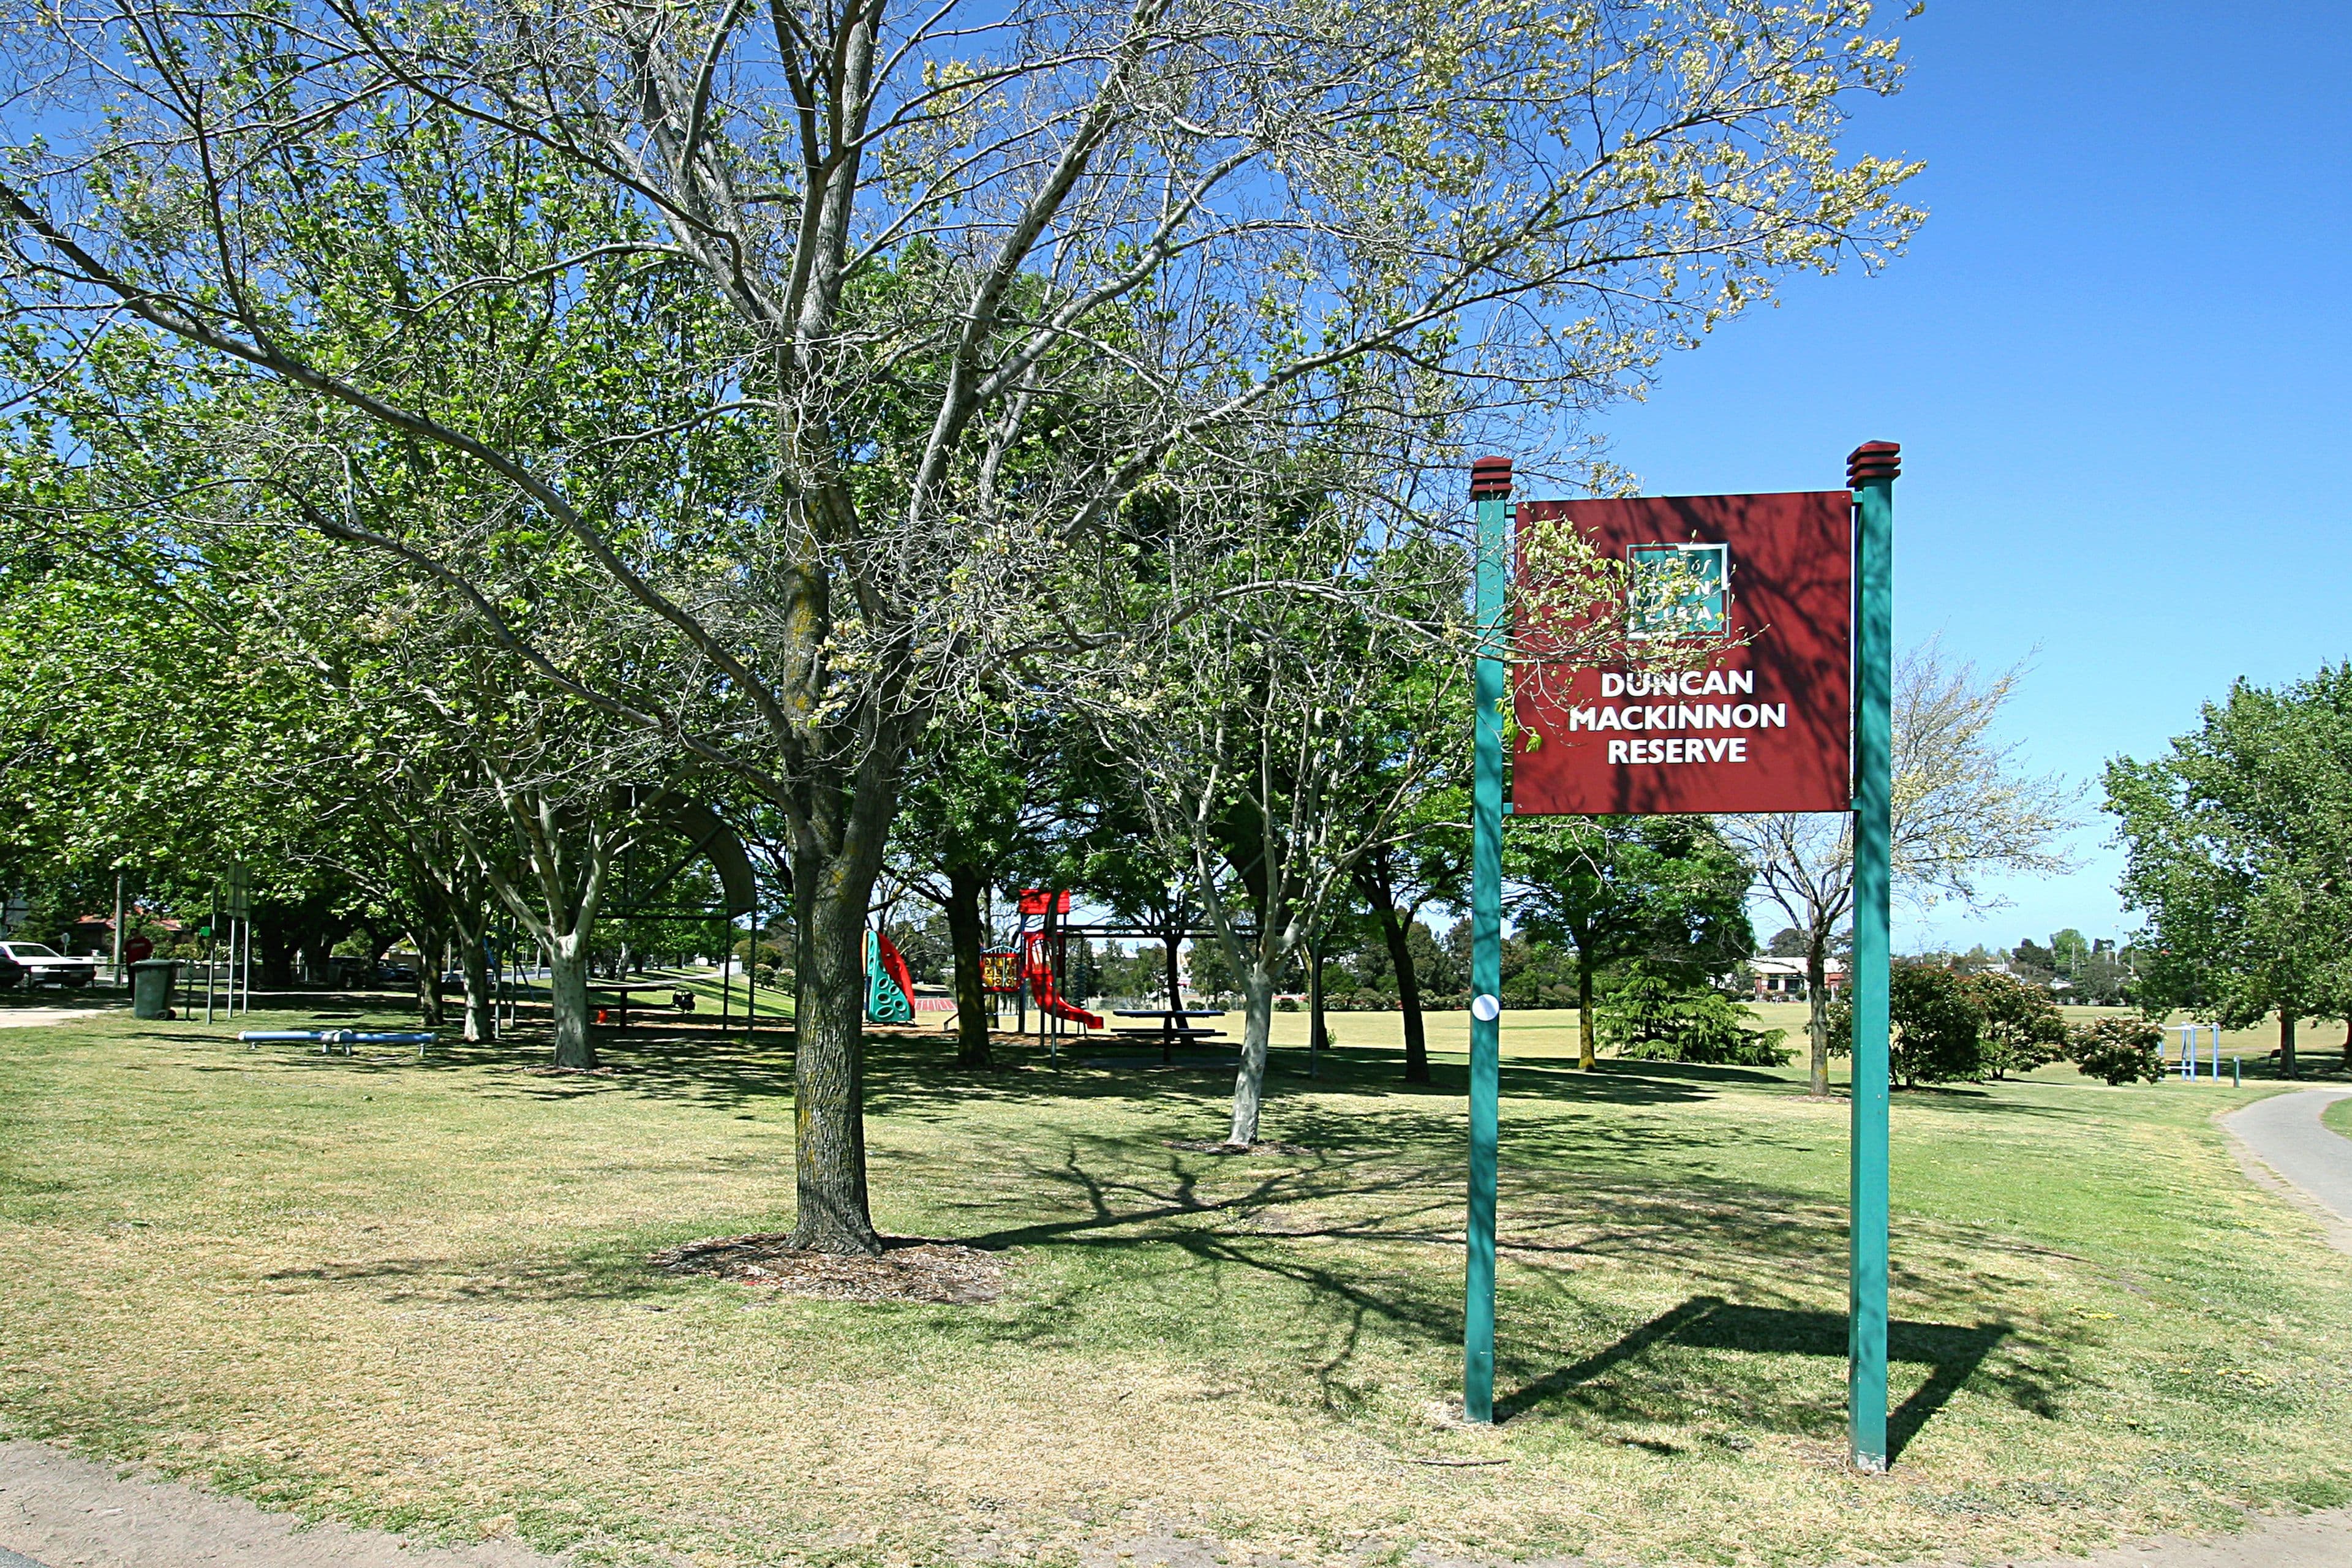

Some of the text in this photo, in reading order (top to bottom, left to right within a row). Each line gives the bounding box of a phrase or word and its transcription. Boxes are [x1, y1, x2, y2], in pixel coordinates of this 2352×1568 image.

[1601, 670, 1753, 697] DUNCAN
[1569, 703, 1785, 731] MACKINNON
[1608, 737, 1746, 764] RESERVE
